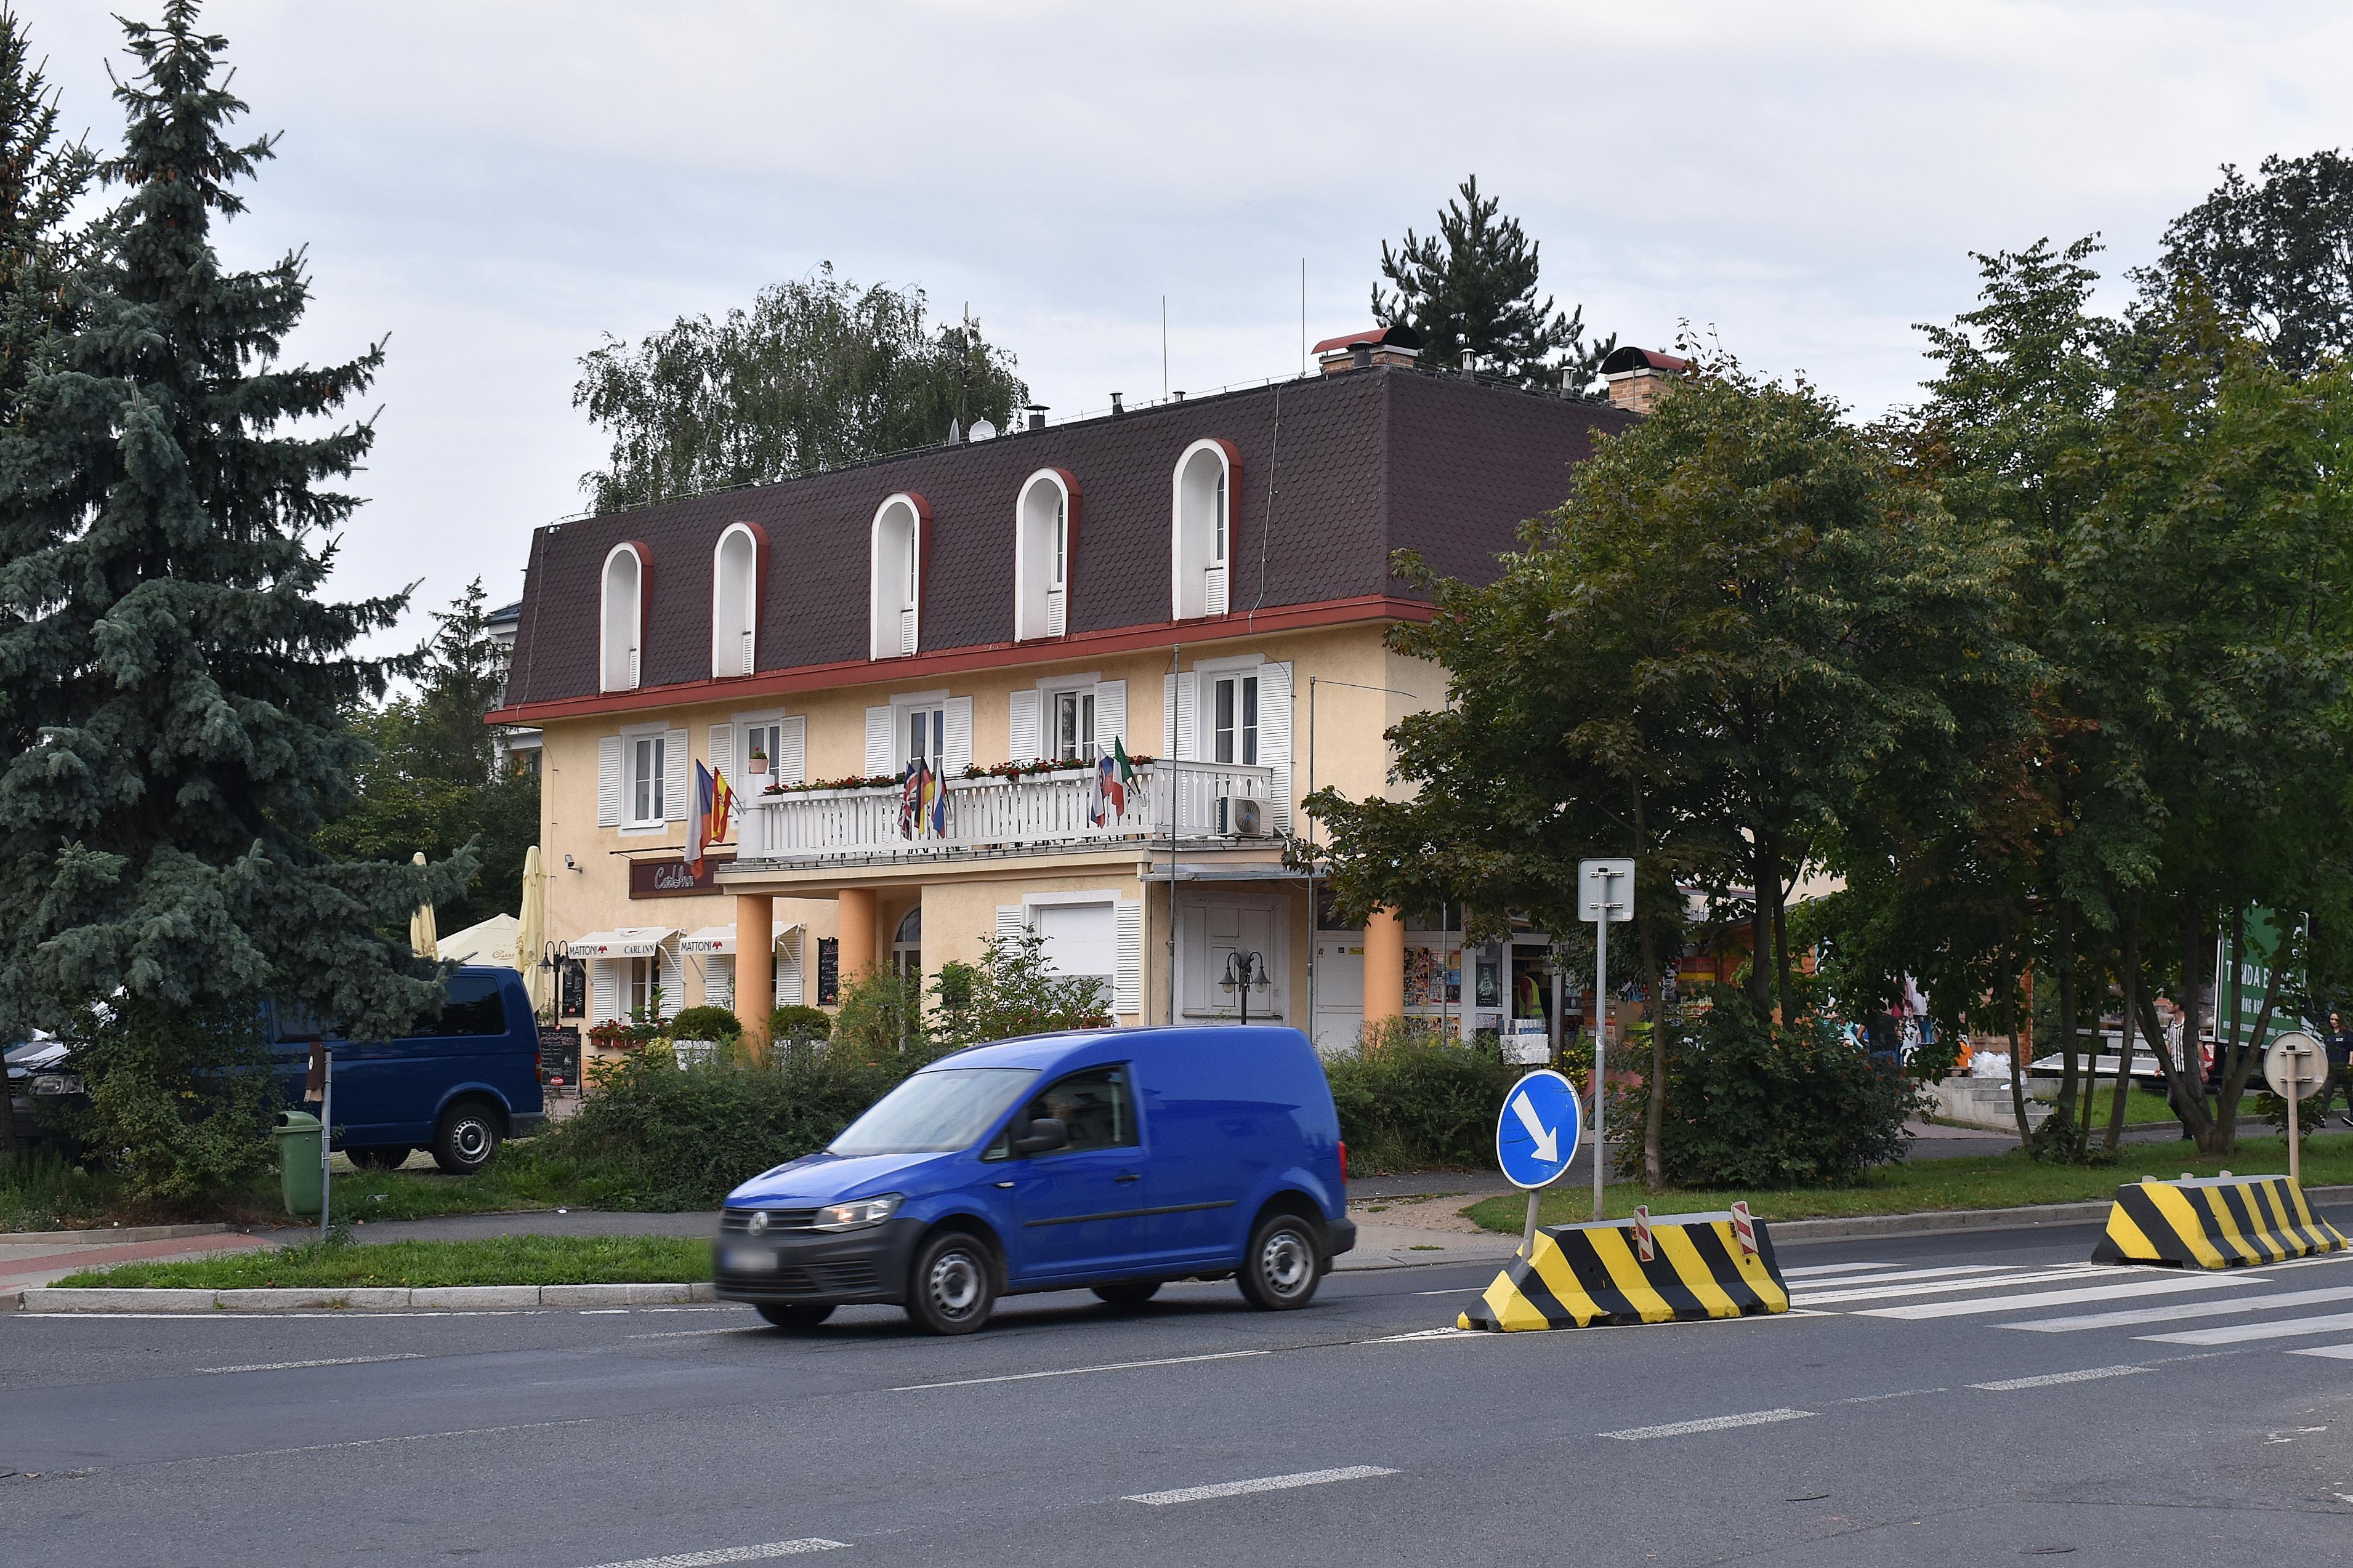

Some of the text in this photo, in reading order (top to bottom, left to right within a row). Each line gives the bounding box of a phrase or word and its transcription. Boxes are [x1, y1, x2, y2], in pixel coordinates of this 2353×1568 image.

[569, 946, 597, 955] MATTONI
[624, 945, 655, 954] CARL INN
[680, 941, 711, 952] MATTONI
[2226, 960, 2260, 988] TMDA
